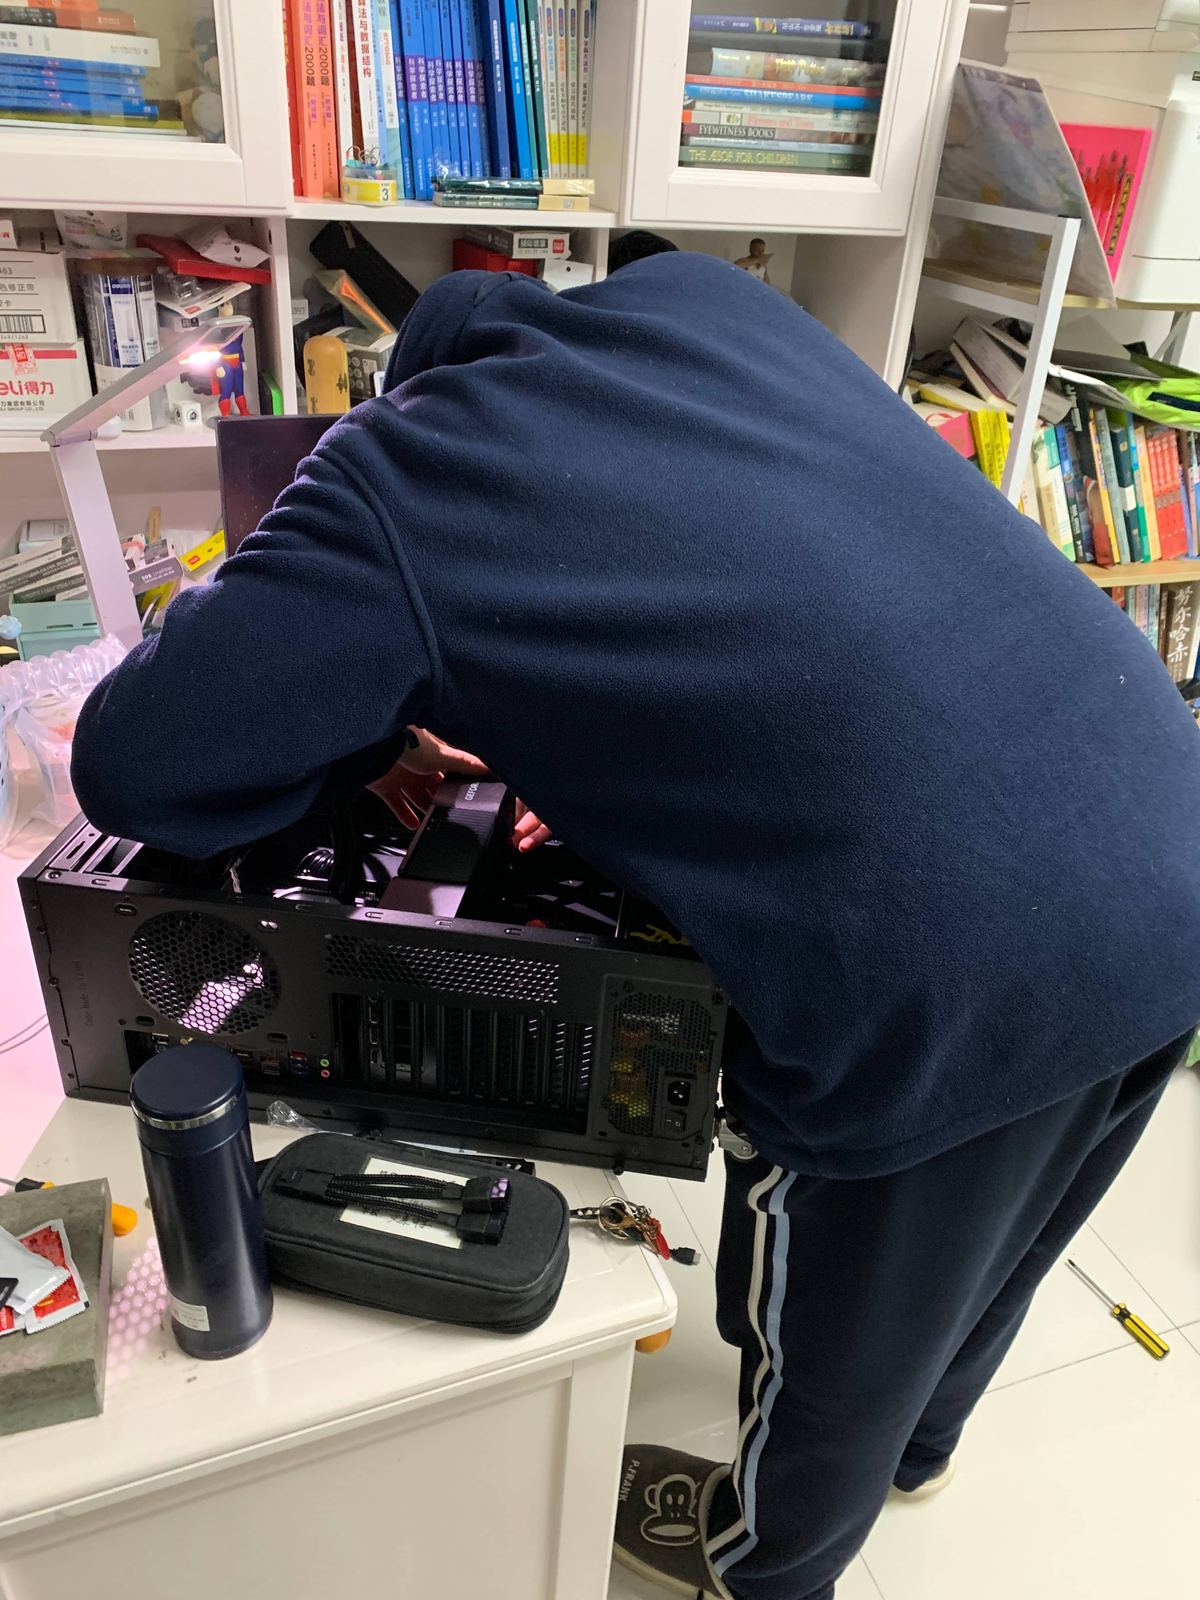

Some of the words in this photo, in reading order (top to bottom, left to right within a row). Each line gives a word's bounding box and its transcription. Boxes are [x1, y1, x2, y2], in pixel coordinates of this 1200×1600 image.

[408, 58, 418, 100] 科学探索者
[418, 56, 427, 98] 科学探索者
[428, 60, 437, 102] 科学探索者
[435, 58, 444, 100] 科学探索者
[446, 61, 455, 102] 科学探索者
[455, 60, 464, 102] 科学探索者
[467, 61, 476, 103] 科学探索者
[699, 125, 746, 137] EYEWITNESS
[748, 127, 775, 138] BOOKS
[689, 149, 706, 161] THE
[735, 151, 752, 163] FOR
[758, 152, 799, 164] CHILDREN
[382, 188, 389, 201] 3
[1167, 585, 1193, 663] 努尔哈赤
[618, 1459, 641, 1502] P.FRANK
